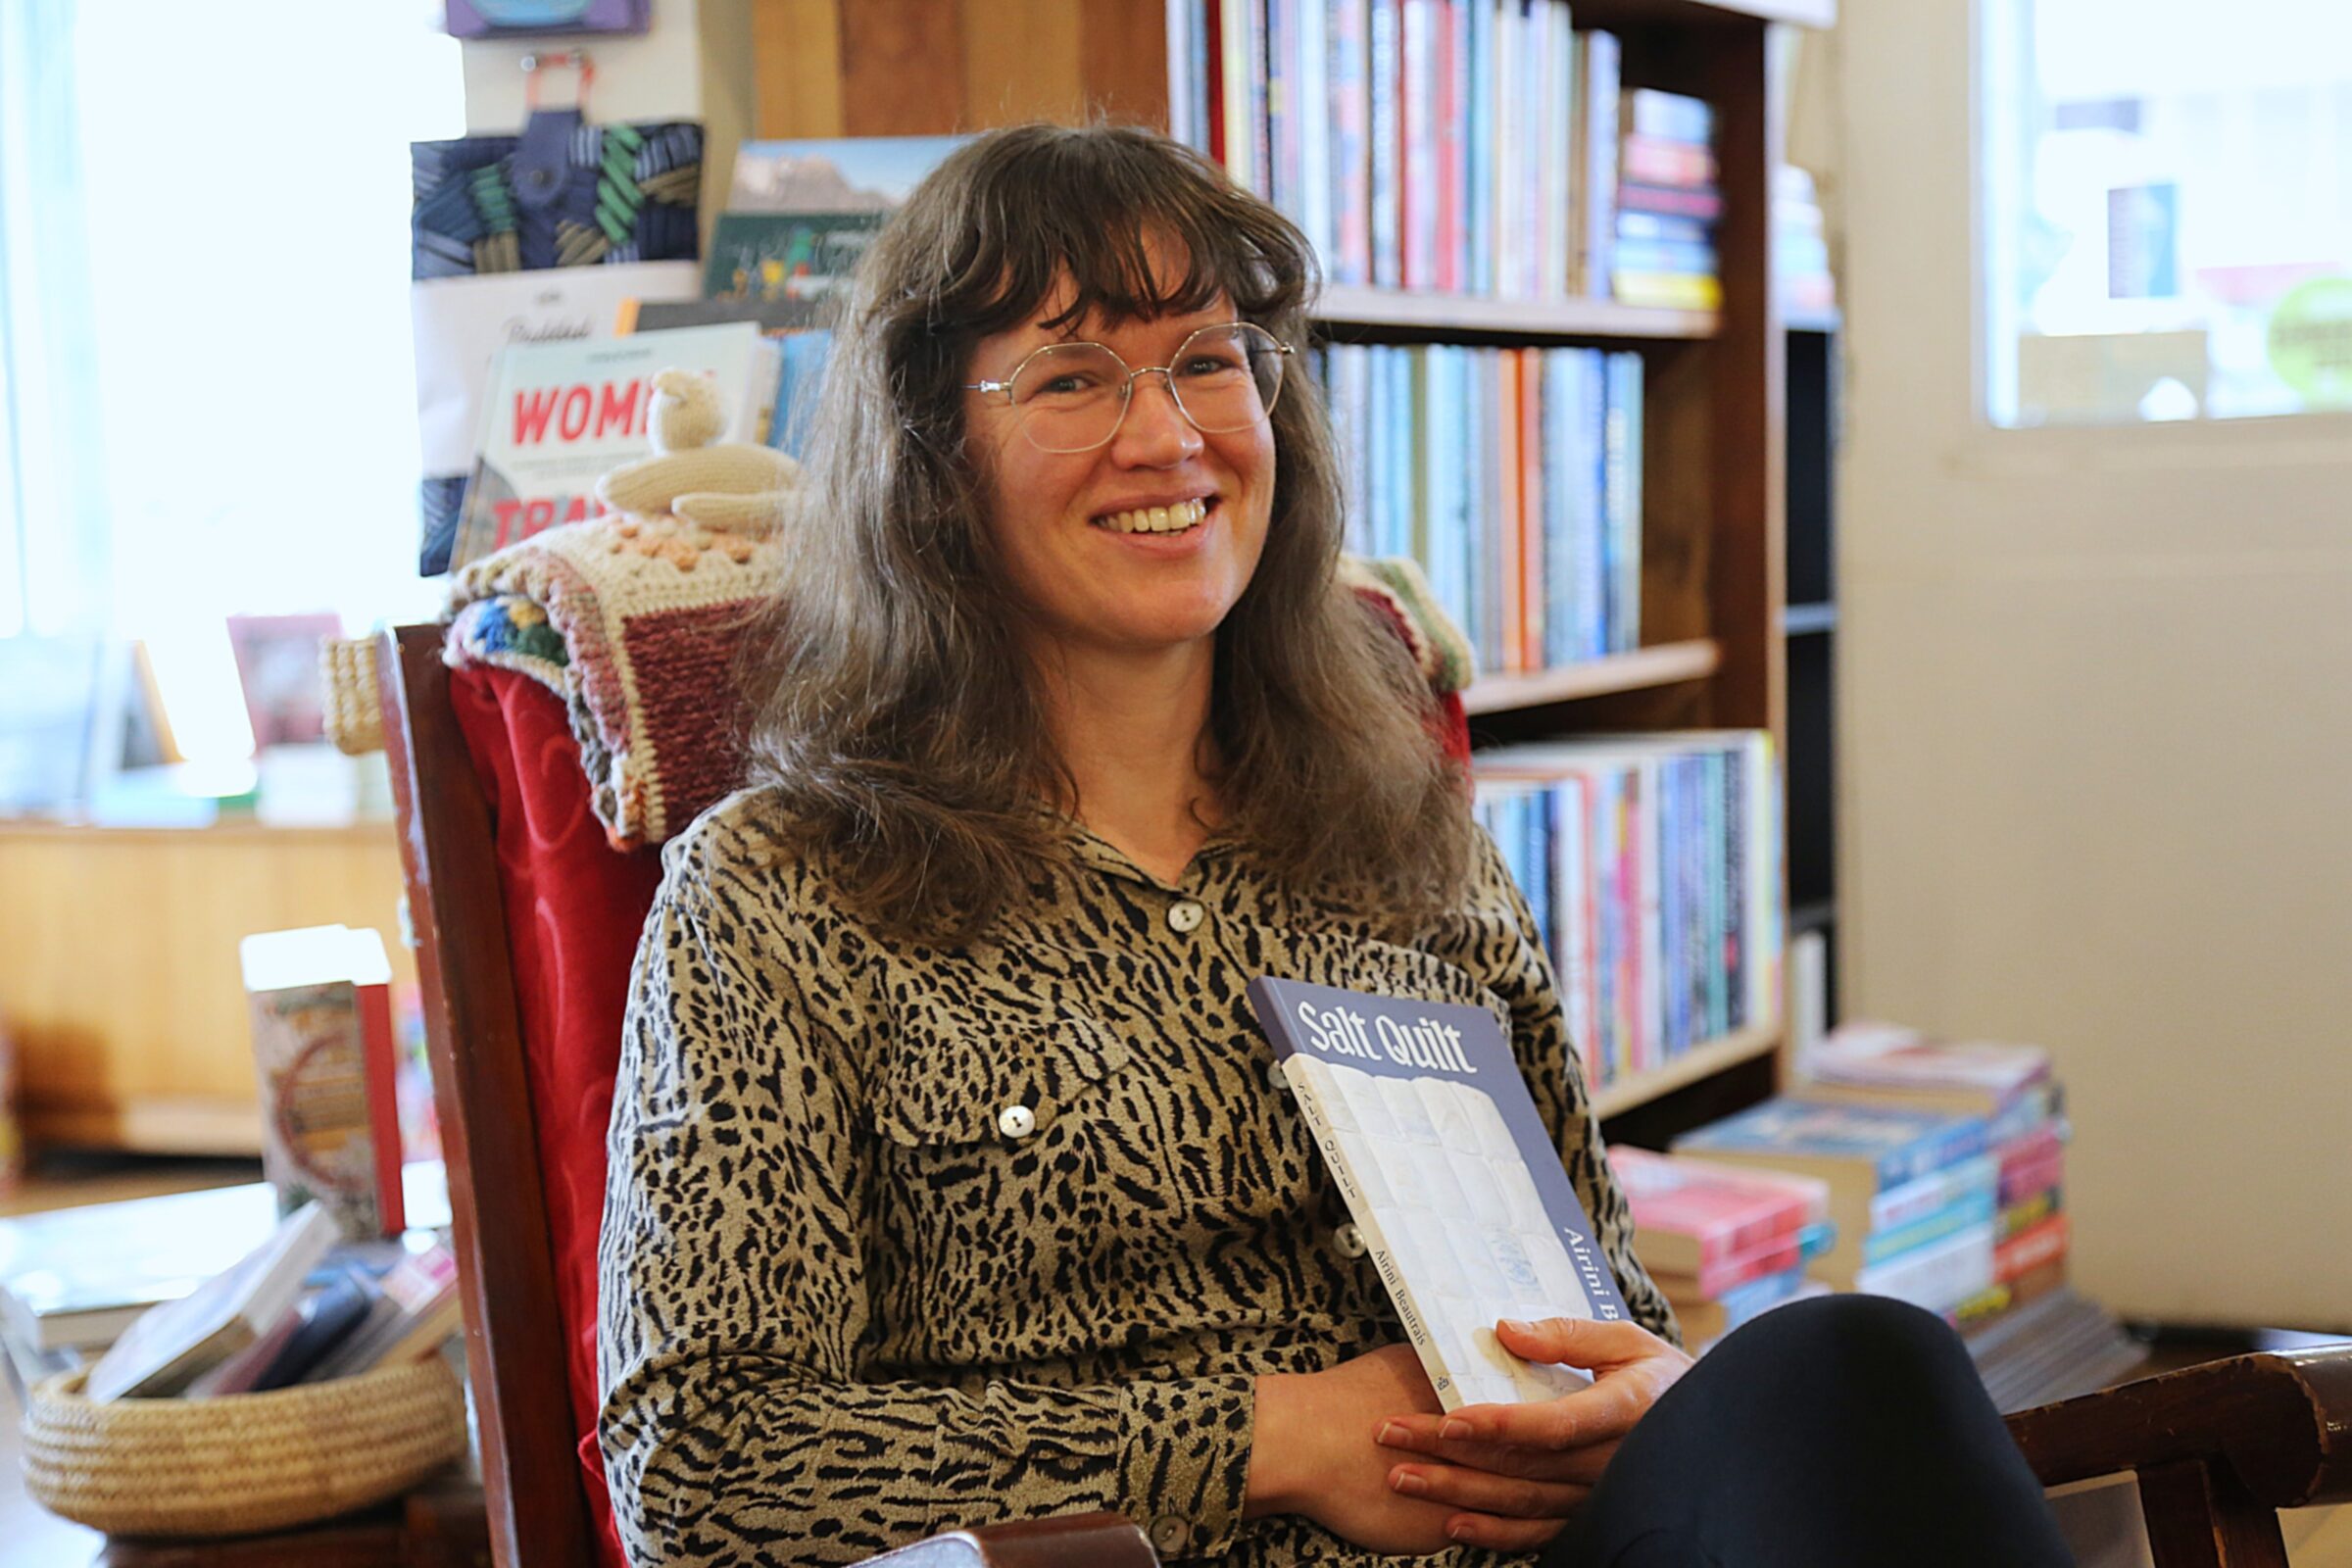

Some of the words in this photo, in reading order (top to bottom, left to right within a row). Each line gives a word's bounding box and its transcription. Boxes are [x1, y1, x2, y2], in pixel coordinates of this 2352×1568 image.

[513, 377, 659, 447] WOM
[492, 495, 606, 551] TR
[1298, 1001, 1383, 1060] Salt
[1374, 1015, 1478, 1074] Quilt
[1298, 1081, 1322, 1127] SALT
[1324, 1139, 1356, 1200] QUILT
[1375, 1250, 1400, 1286] Airini
[1396, 1289, 1426, 1346] Beautrais
[1563, 1227, 1611, 1297] Airini
[1598, 1303, 1620, 1320] B
